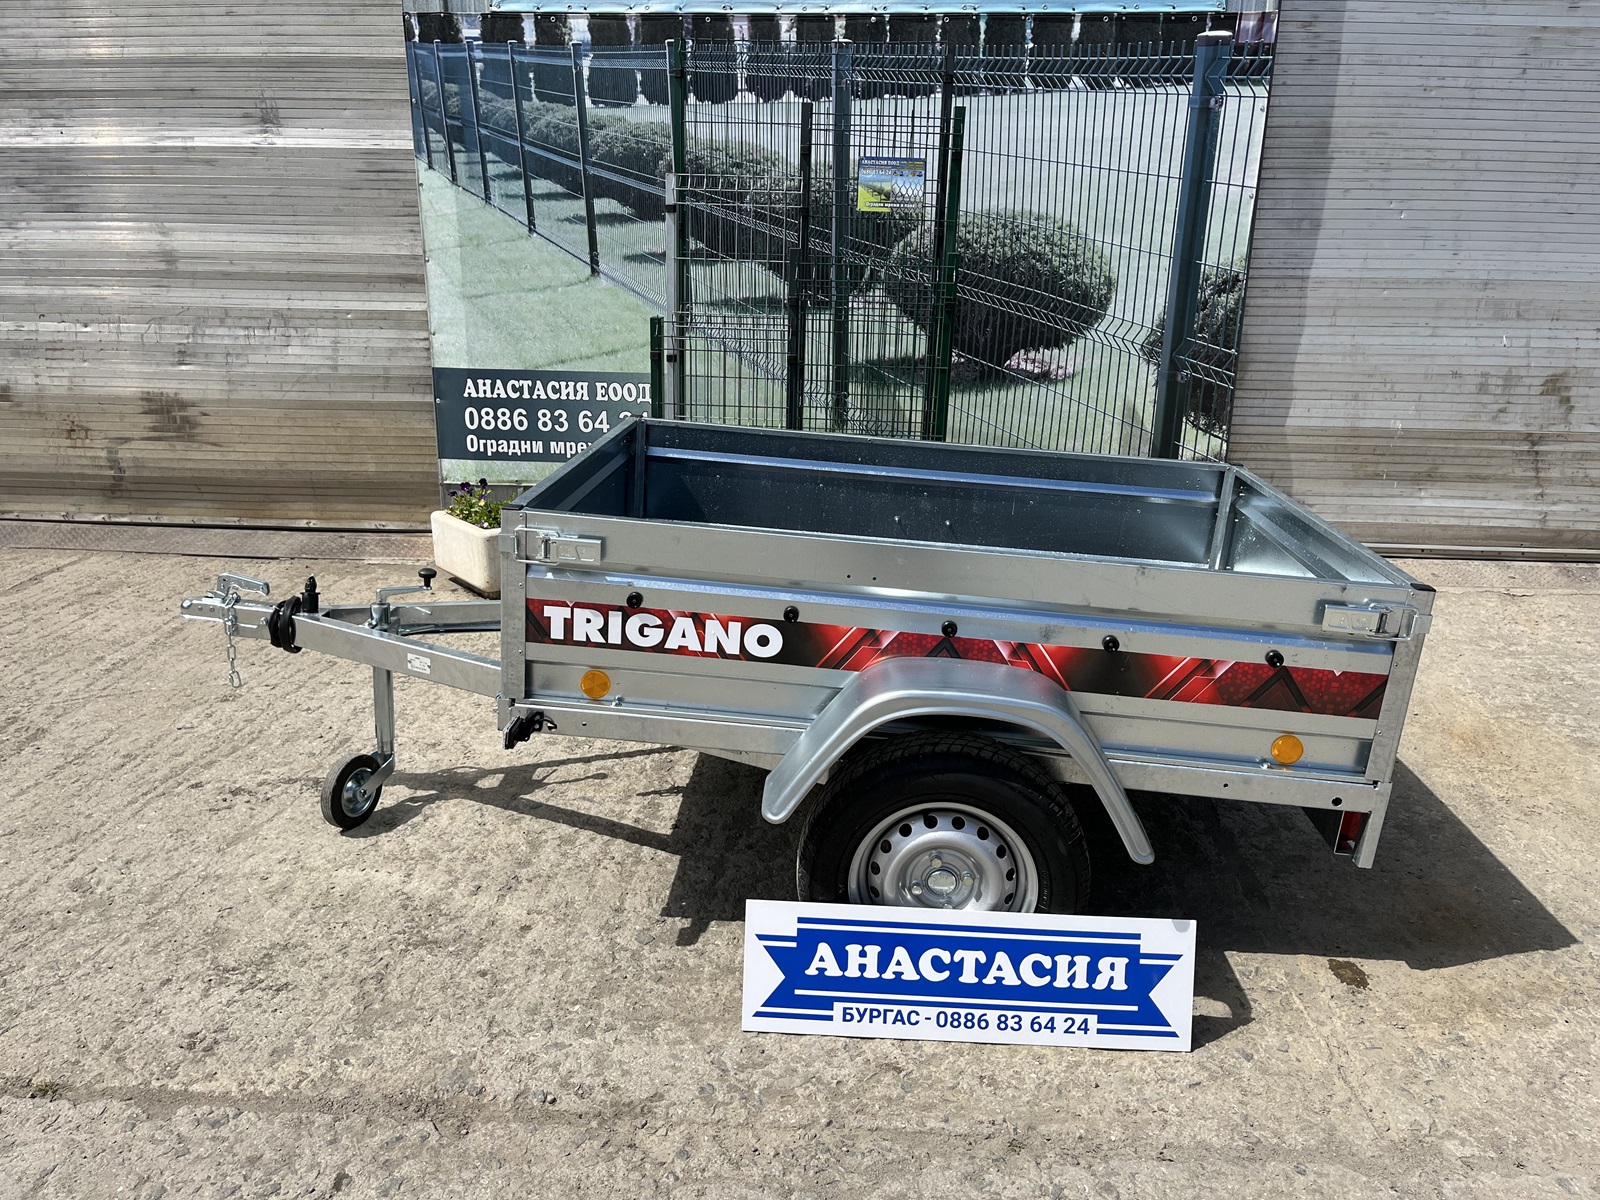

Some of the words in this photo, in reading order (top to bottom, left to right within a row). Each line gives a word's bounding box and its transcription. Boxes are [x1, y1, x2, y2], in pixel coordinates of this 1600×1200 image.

[463, 378, 590, 401] АНАСТАСИЯ
[595, 382, 652, 404] ЕООД
[464, 406, 529, 431] 0886
[537, 408, 569, 432] 83
[578, 410, 610, 433] 64
[466, 434, 543, 456] Оградни
[550, 441, 592, 458] мре
[543, 605, 783, 658] TRIGANO
[804, 942, 1129, 991] АНАСТАСИЯ
[841, 1006, 921, 1026] БУРГАС
[935, 1010, 990, 1030] 0886
[996, 1014, 1023, 1032] 83
[1029, 1016, 1057, 1034] 64
[1063, 1017, 1090, 1035] 24
